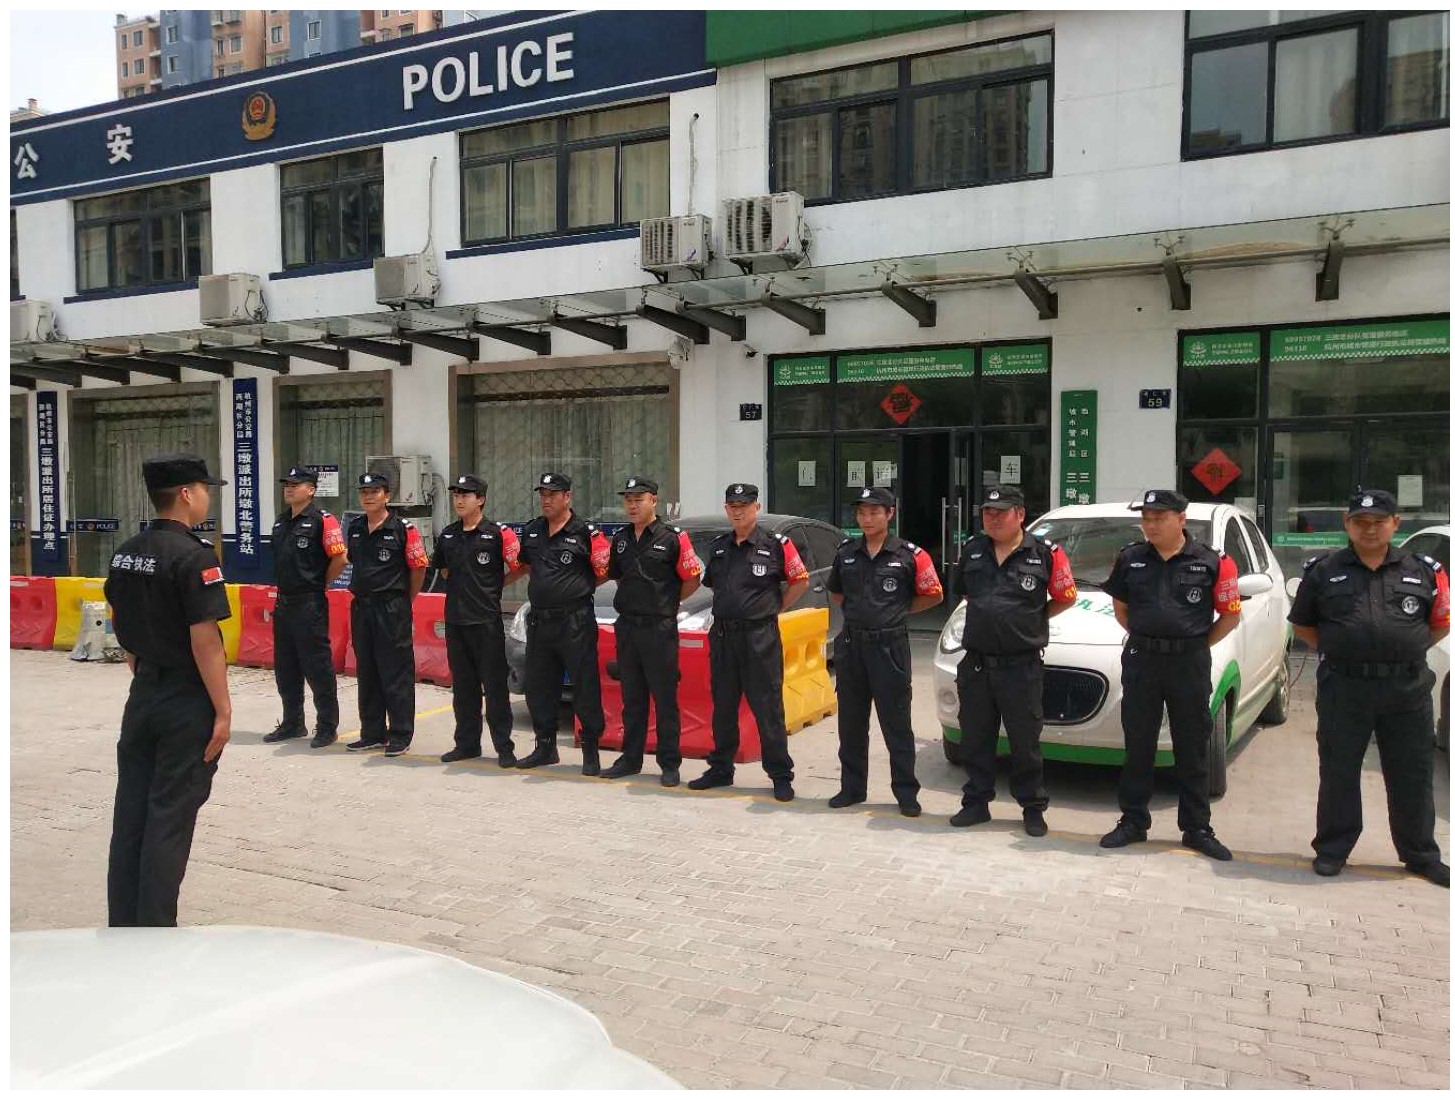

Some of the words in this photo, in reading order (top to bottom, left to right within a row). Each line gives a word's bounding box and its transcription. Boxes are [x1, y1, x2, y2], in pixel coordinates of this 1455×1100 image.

[402, 32, 574, 110] POLICE
[14, 123, 134, 179] 公安
[745, 411, 757, 419] 57
[1148, 398, 1163, 408] 59
[237, 442, 255, 555] 三墩派出所墩北警务站
[111, 554, 157, 573] 综合执法
